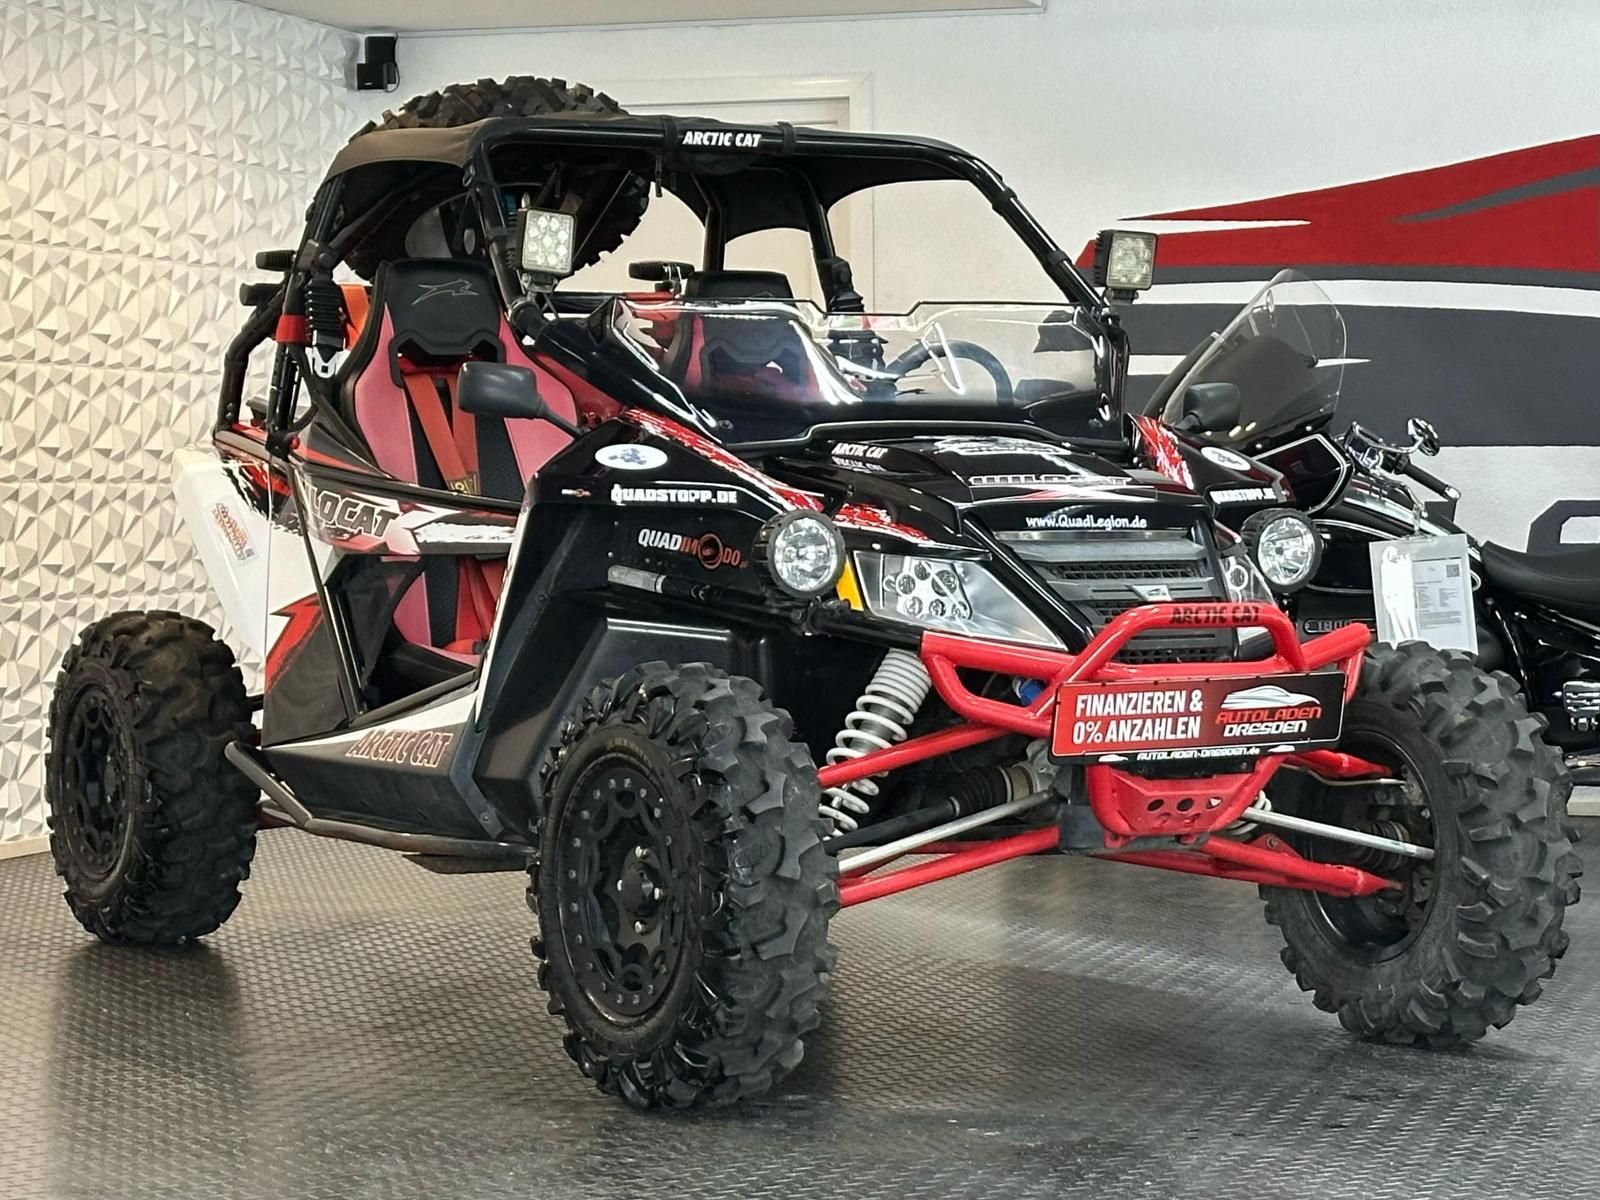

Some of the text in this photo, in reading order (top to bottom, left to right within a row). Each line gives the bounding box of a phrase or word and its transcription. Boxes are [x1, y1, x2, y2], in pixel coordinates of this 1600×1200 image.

[682, 131, 761, 148] ARCTIC CAT
[831, 442, 888, 459] ARCTIC CAT
[610, 483, 737, 505] QUADSTOPP.DE
[1025, 514, 1147, 530] www.QuadLegion.de
[1170, 606, 1259, 624] ARCTIC CAT
[1076, 689, 1203, 717] FINANZIEREN &
[1216, 707, 1322, 724] AUTOLADEN
[1072, 716, 1201, 745] 0% ANZAHLEN
[1223, 720, 1307, 737] DRESDEN
[345, 729, 454, 768] ARCTIC CAT
